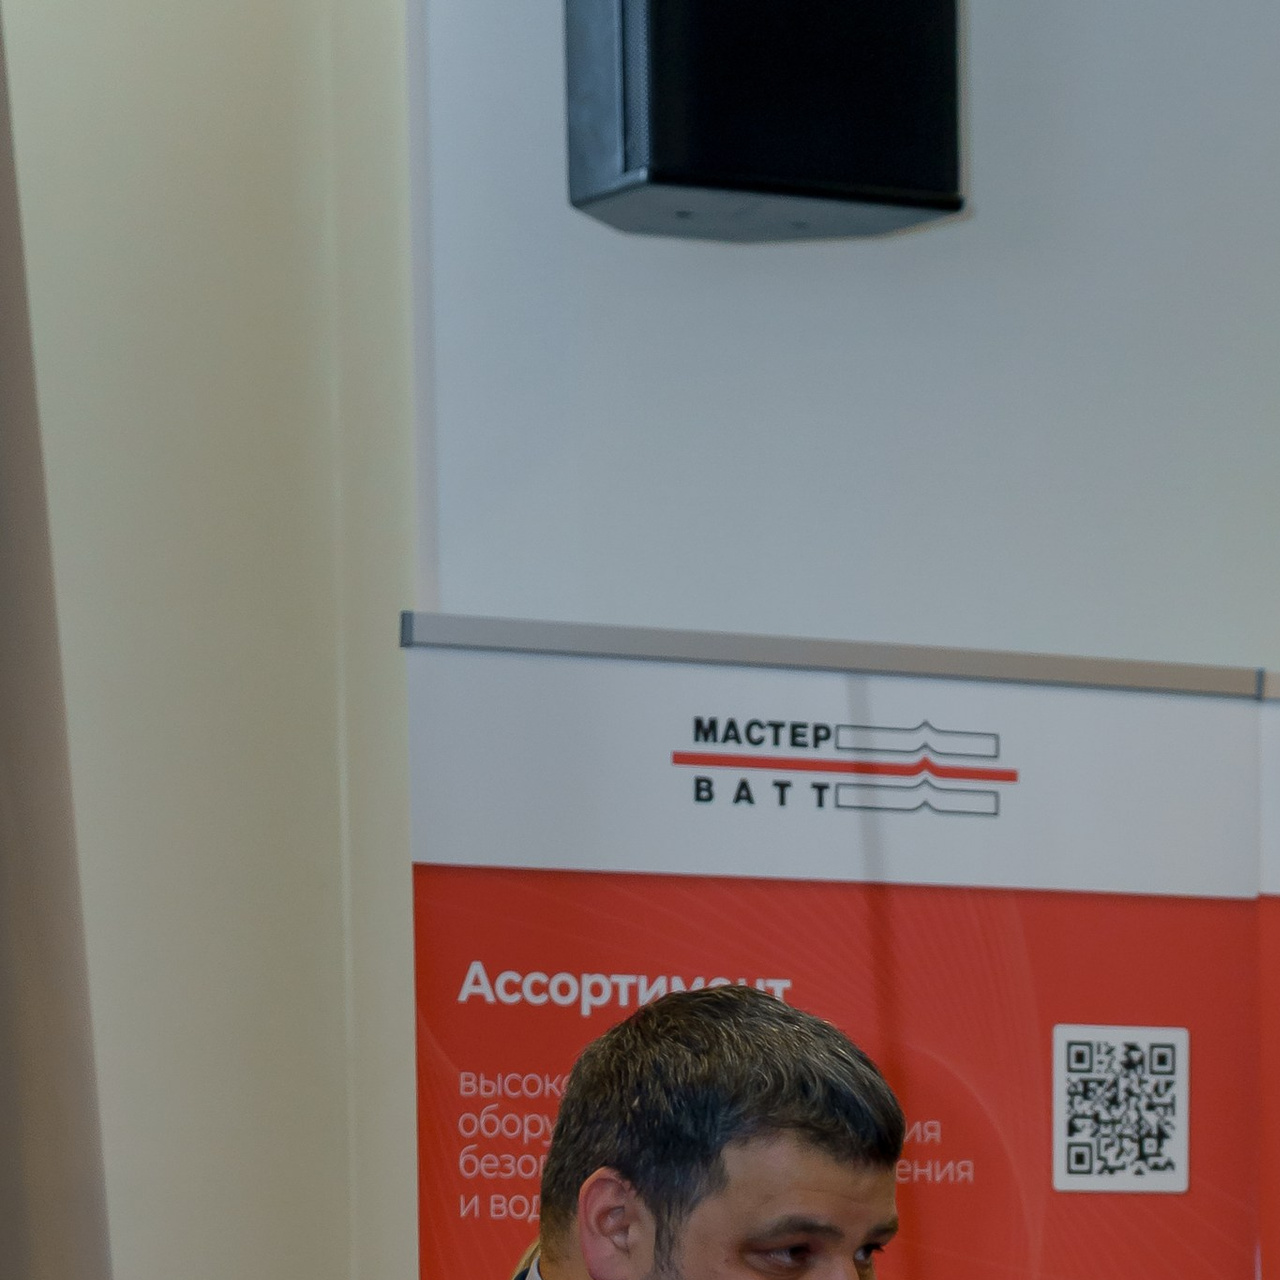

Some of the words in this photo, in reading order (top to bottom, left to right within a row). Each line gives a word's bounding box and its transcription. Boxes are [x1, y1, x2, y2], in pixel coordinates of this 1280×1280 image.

[694, 716, 832, 749] МАСТЕР
[694, 776, 830, 808] ВАТТ
[457, 959, 792, 1017] Ассортит
[459, 1072, 570, 1097] высок
[460, 1194, 480, 1219] и
